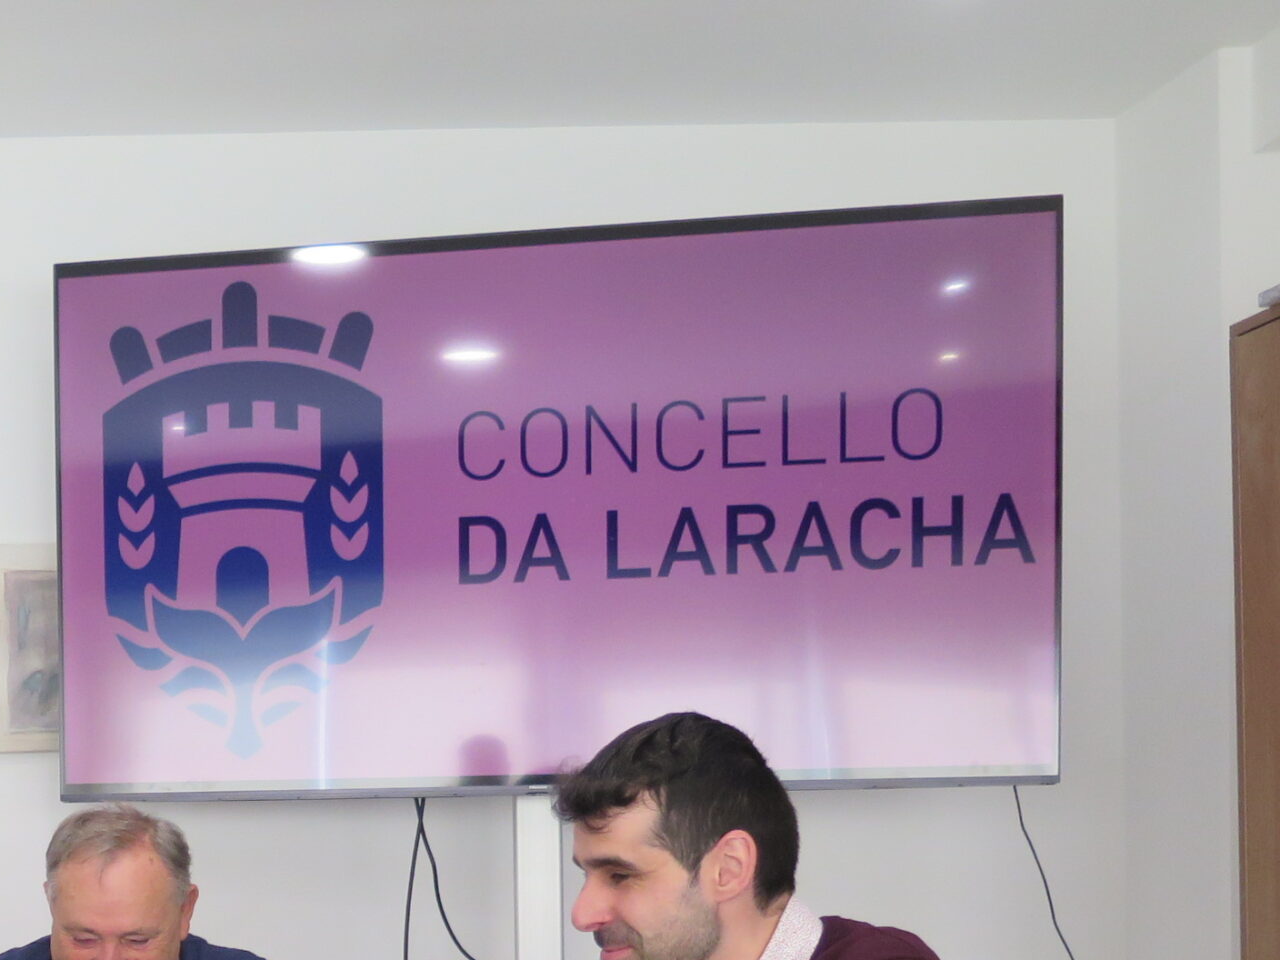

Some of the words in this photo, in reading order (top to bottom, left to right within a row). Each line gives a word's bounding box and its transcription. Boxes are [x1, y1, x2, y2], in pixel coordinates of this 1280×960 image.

[457, 387, 944, 481] CONCELLO
[458, 512, 572, 585] DA
[606, 492, 1037, 580] LARACHA
